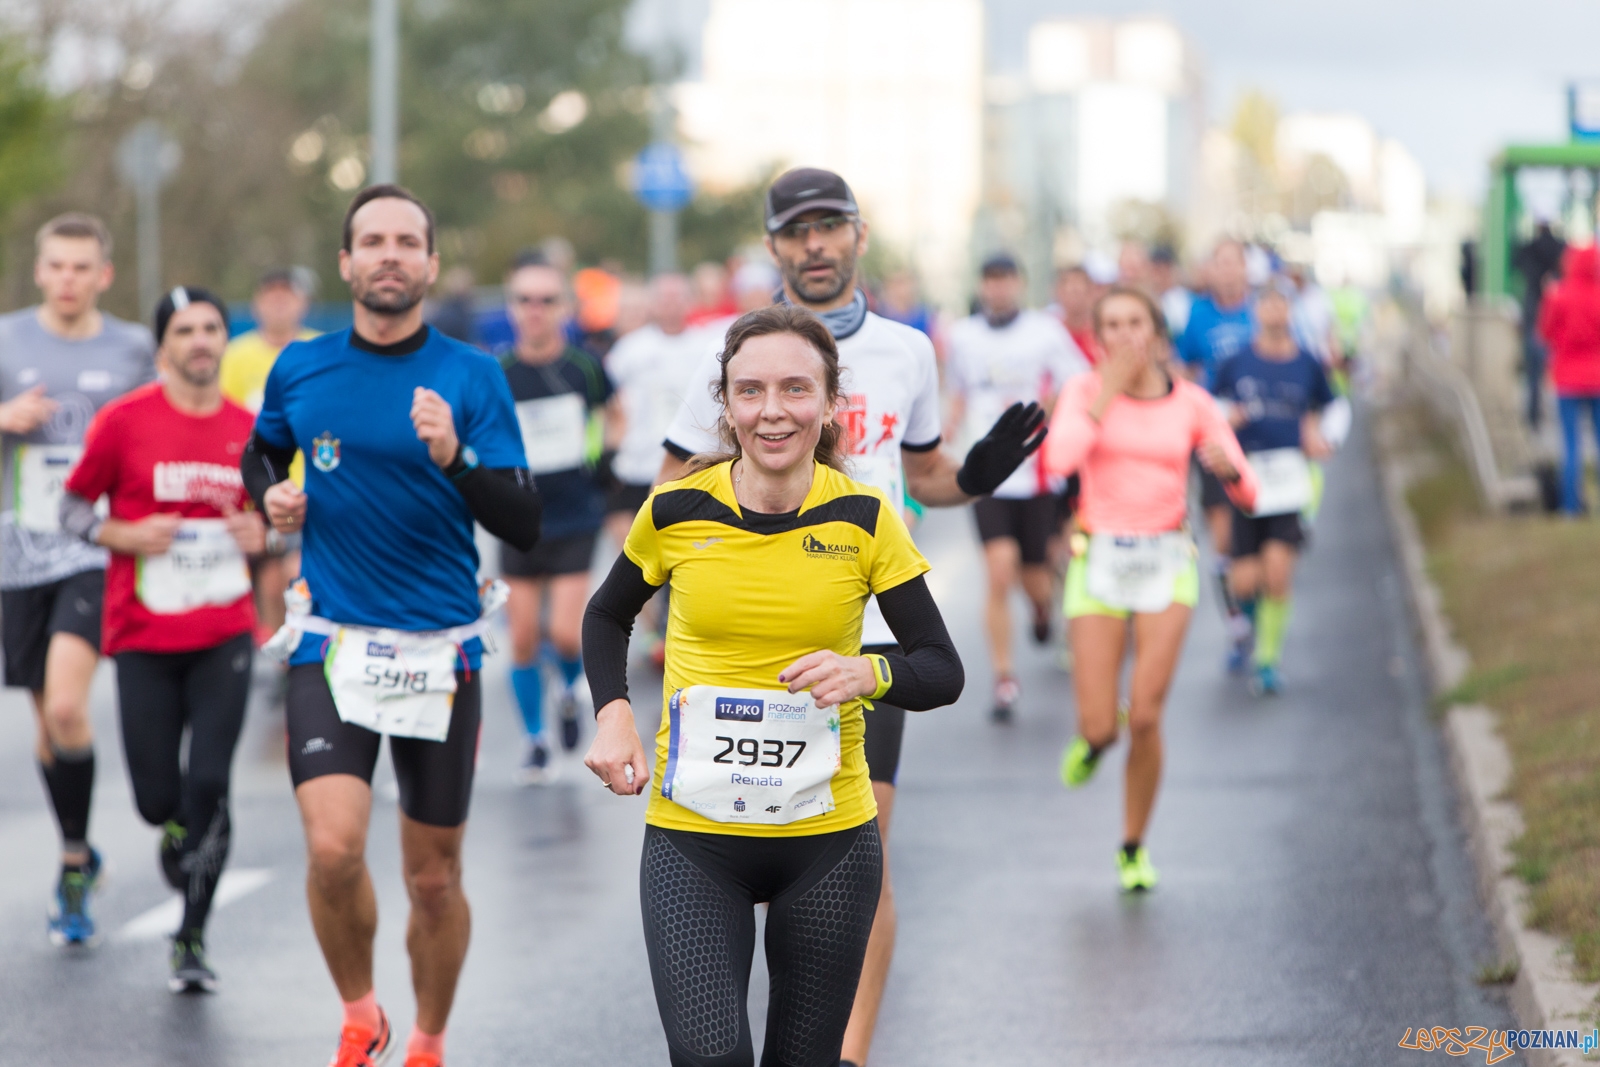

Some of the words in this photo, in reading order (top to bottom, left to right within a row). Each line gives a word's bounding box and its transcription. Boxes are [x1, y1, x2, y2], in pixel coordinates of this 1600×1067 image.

[827, 543, 860, 554] KAUNO
[806, 553, 839, 561] MARATONO
[719, 703, 734, 714] 17.
[735, 704, 760, 716] PKO
[768, 711, 806, 720] maraton
[713, 735, 807, 769] 2937
[731, 773, 783, 787] Renata
[765, 805, 782, 814] 4F
